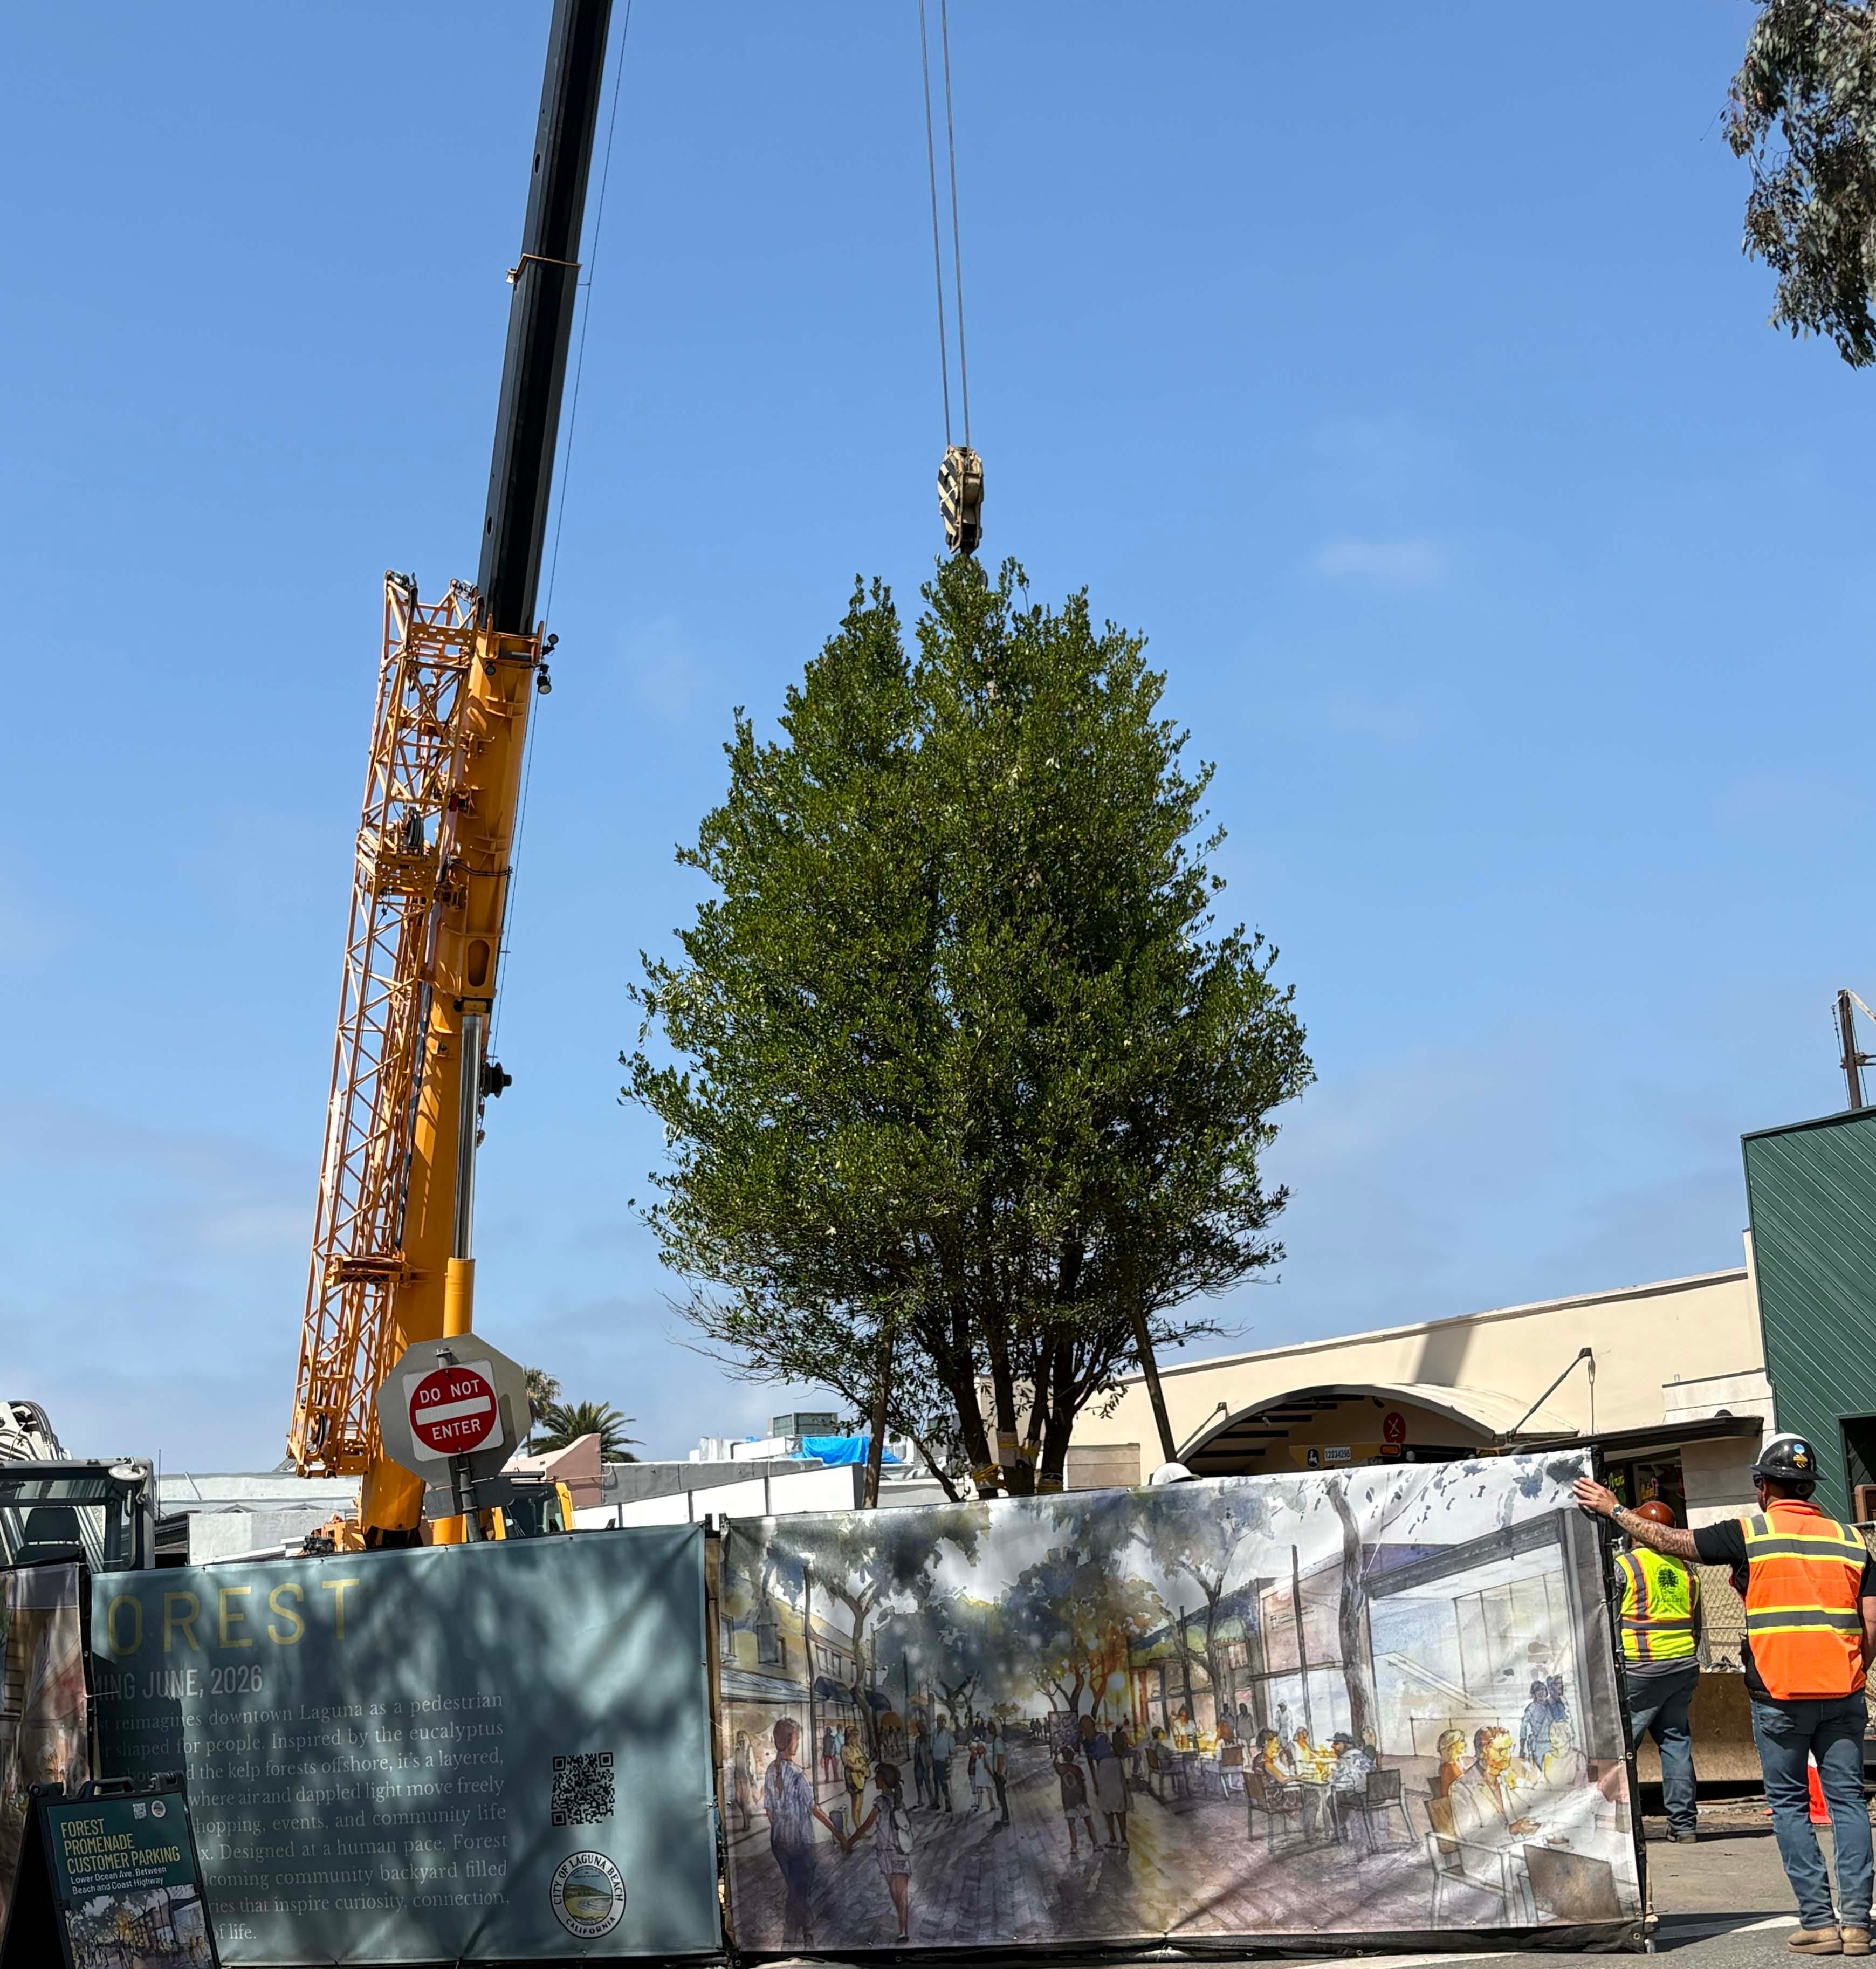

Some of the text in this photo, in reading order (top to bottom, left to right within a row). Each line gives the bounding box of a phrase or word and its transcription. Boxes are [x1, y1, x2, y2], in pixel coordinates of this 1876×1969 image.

[419, 1379, 479, 1404] DO NOT
[432, 1418, 482, 1441] ENTER
[108, 1578, 360, 1656] OREST
[94, 1664, 262, 1700] MING JUNE, 2026
[116, 1712, 201, 1732] reimagines
[209, 1708, 292, 1725] downtown
[300, 1704, 363, 1723] Laguna
[369, 1703, 386, 1716] as
[394, 1702, 403, 1714] a
[410, 1692, 503, 1717] pedestrian
[116, 1739, 169, 1760] shaped
[177, 1738, 201, 1753] for
[207, 1734, 265, 1757] people.
[272, 1728, 341, 1752] Inspired
[349, 1728, 368, 1748] by
[375, 1726, 403, 1743] the
[410, 1721, 504, 1742] eucalyptus
[200, 1763, 223, 1779] the
[228, 1761, 260, 1782] kelp
[266, 1760, 317, 1776] forests
[321, 1755, 393, 1773] offshore,
[397, 1752, 420, 1769] it's
[425, 1755, 435, 1767] a
[439, 1747, 504, 1770] layered,
[189, 1775, 504, 1806] where air and dappled light move freely
[60, 1818, 104, 1838] FOREST
[196, 1803, 506, 1837] hopping, events, and community life
[64, 1834, 135, 1856] PROMENADE
[67, 1845, 181, 1874] CUSTOMER PARKING
[219, 1841, 295, 1863] Designed
[302, 1843, 317, 1856] at
[323, 1844, 331, 1855] a
[338, 1839, 396, 1855] human
[404, 1838, 446, 1855] pace,
[453, 1834, 508, 1850] Forest
[71, 1867, 167, 1884] Lower Ocean Ave. Between
[72, 1877, 163, 1895] Beach and Coast Highway
[203, 1860, 507, 1889] lcoming community backyard filled
[553, 1880, 563, 1905] CITY
[558, 1865, 569, 1879] OF
[569, 1854, 607, 1870] LAGUNA
[607, 1867, 623, 1901] BEACH
[209, 1889, 510, 1915] ries that inspire curiosity, connection,
[230, 1924, 257, 1939] life.
[566, 1916, 616, 1934] CALIFORNIA
